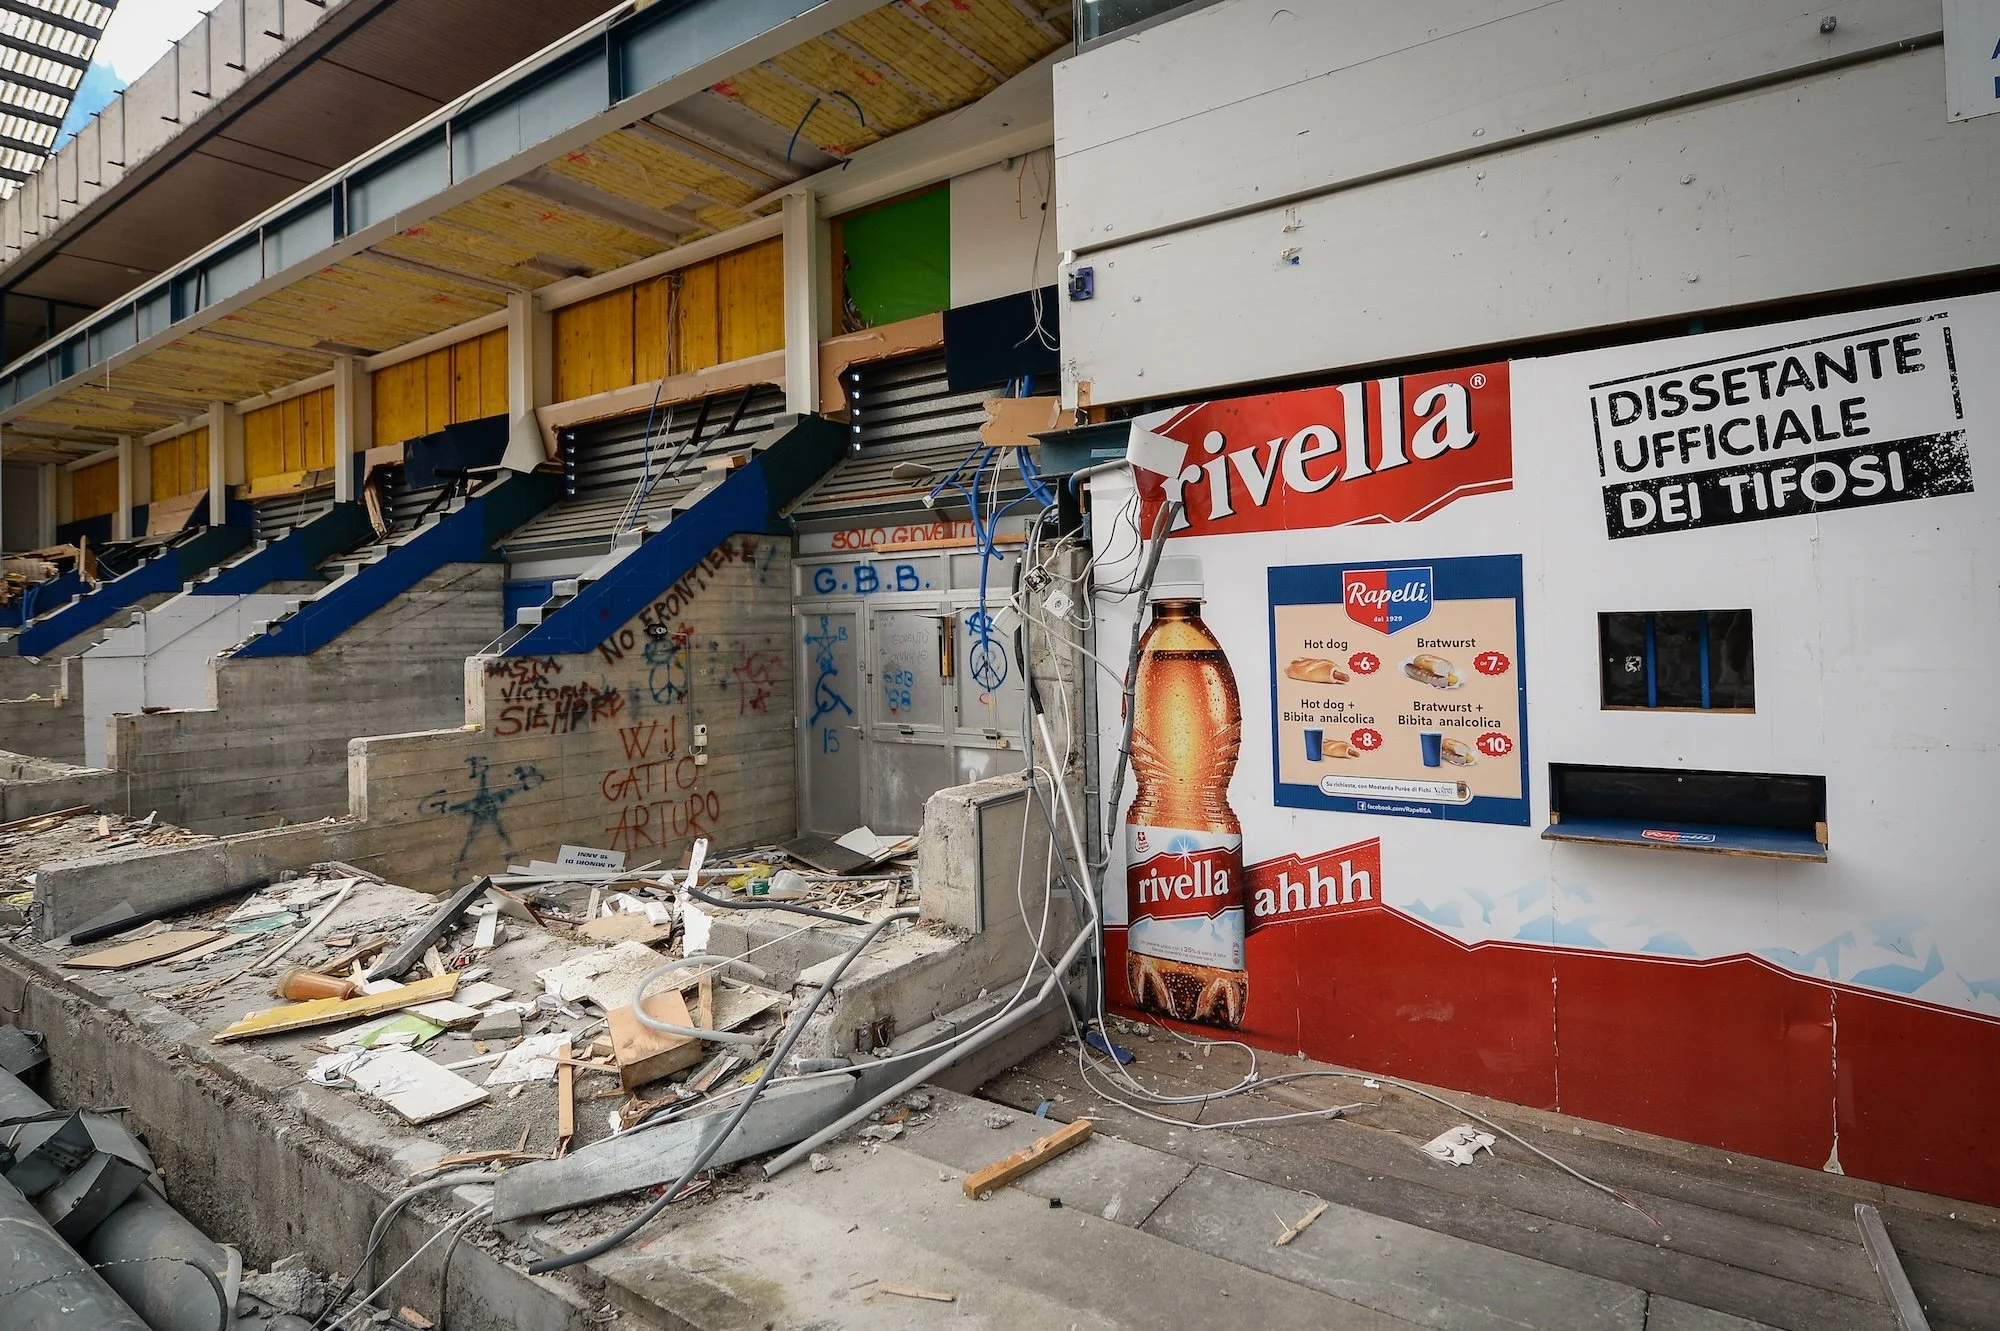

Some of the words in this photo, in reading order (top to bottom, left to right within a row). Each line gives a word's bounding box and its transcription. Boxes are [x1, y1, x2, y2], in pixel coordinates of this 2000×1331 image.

[1609, 332, 1925, 427] DISSETANTE
[1614, 397, 1870, 473] UFFICIALE
[1161, 377, 1477, 532] rivella
[1620, 482, 1702, 528] DEI
[1719, 451, 1905, 514] TIFOSI
[831, 528, 886, 549] SOLO
[1347, 582, 1428, 609] Rapelli
[598, 629, 635, 667] NO
[1304, 639, 1323, 649] Hot
[1326, 638, 1348, 651] dog
[1417, 637, 1476, 649] Bratwurst
[1283, 712, 1314, 723] Bibita
[1319, 713, 1375, 724] analcolica
[1301, 699, 1321, 709] Hot
[1323, 699, 1344, 712] dog
[1398, 715, 1433, 726] Bibita
[1439, 716, 1501, 728] analcolica
[1413, 701, 1472, 713] Bratwurst
[1475, 704, 1484, 712] +
[602, 756, 699, 801] GATTO
[605, 790, 721, 853] ARTURO
[576, 860, 605, 868] MINORI
[1138, 859, 1230, 903] rivella
[1254, 860, 1373, 917] ahhh
